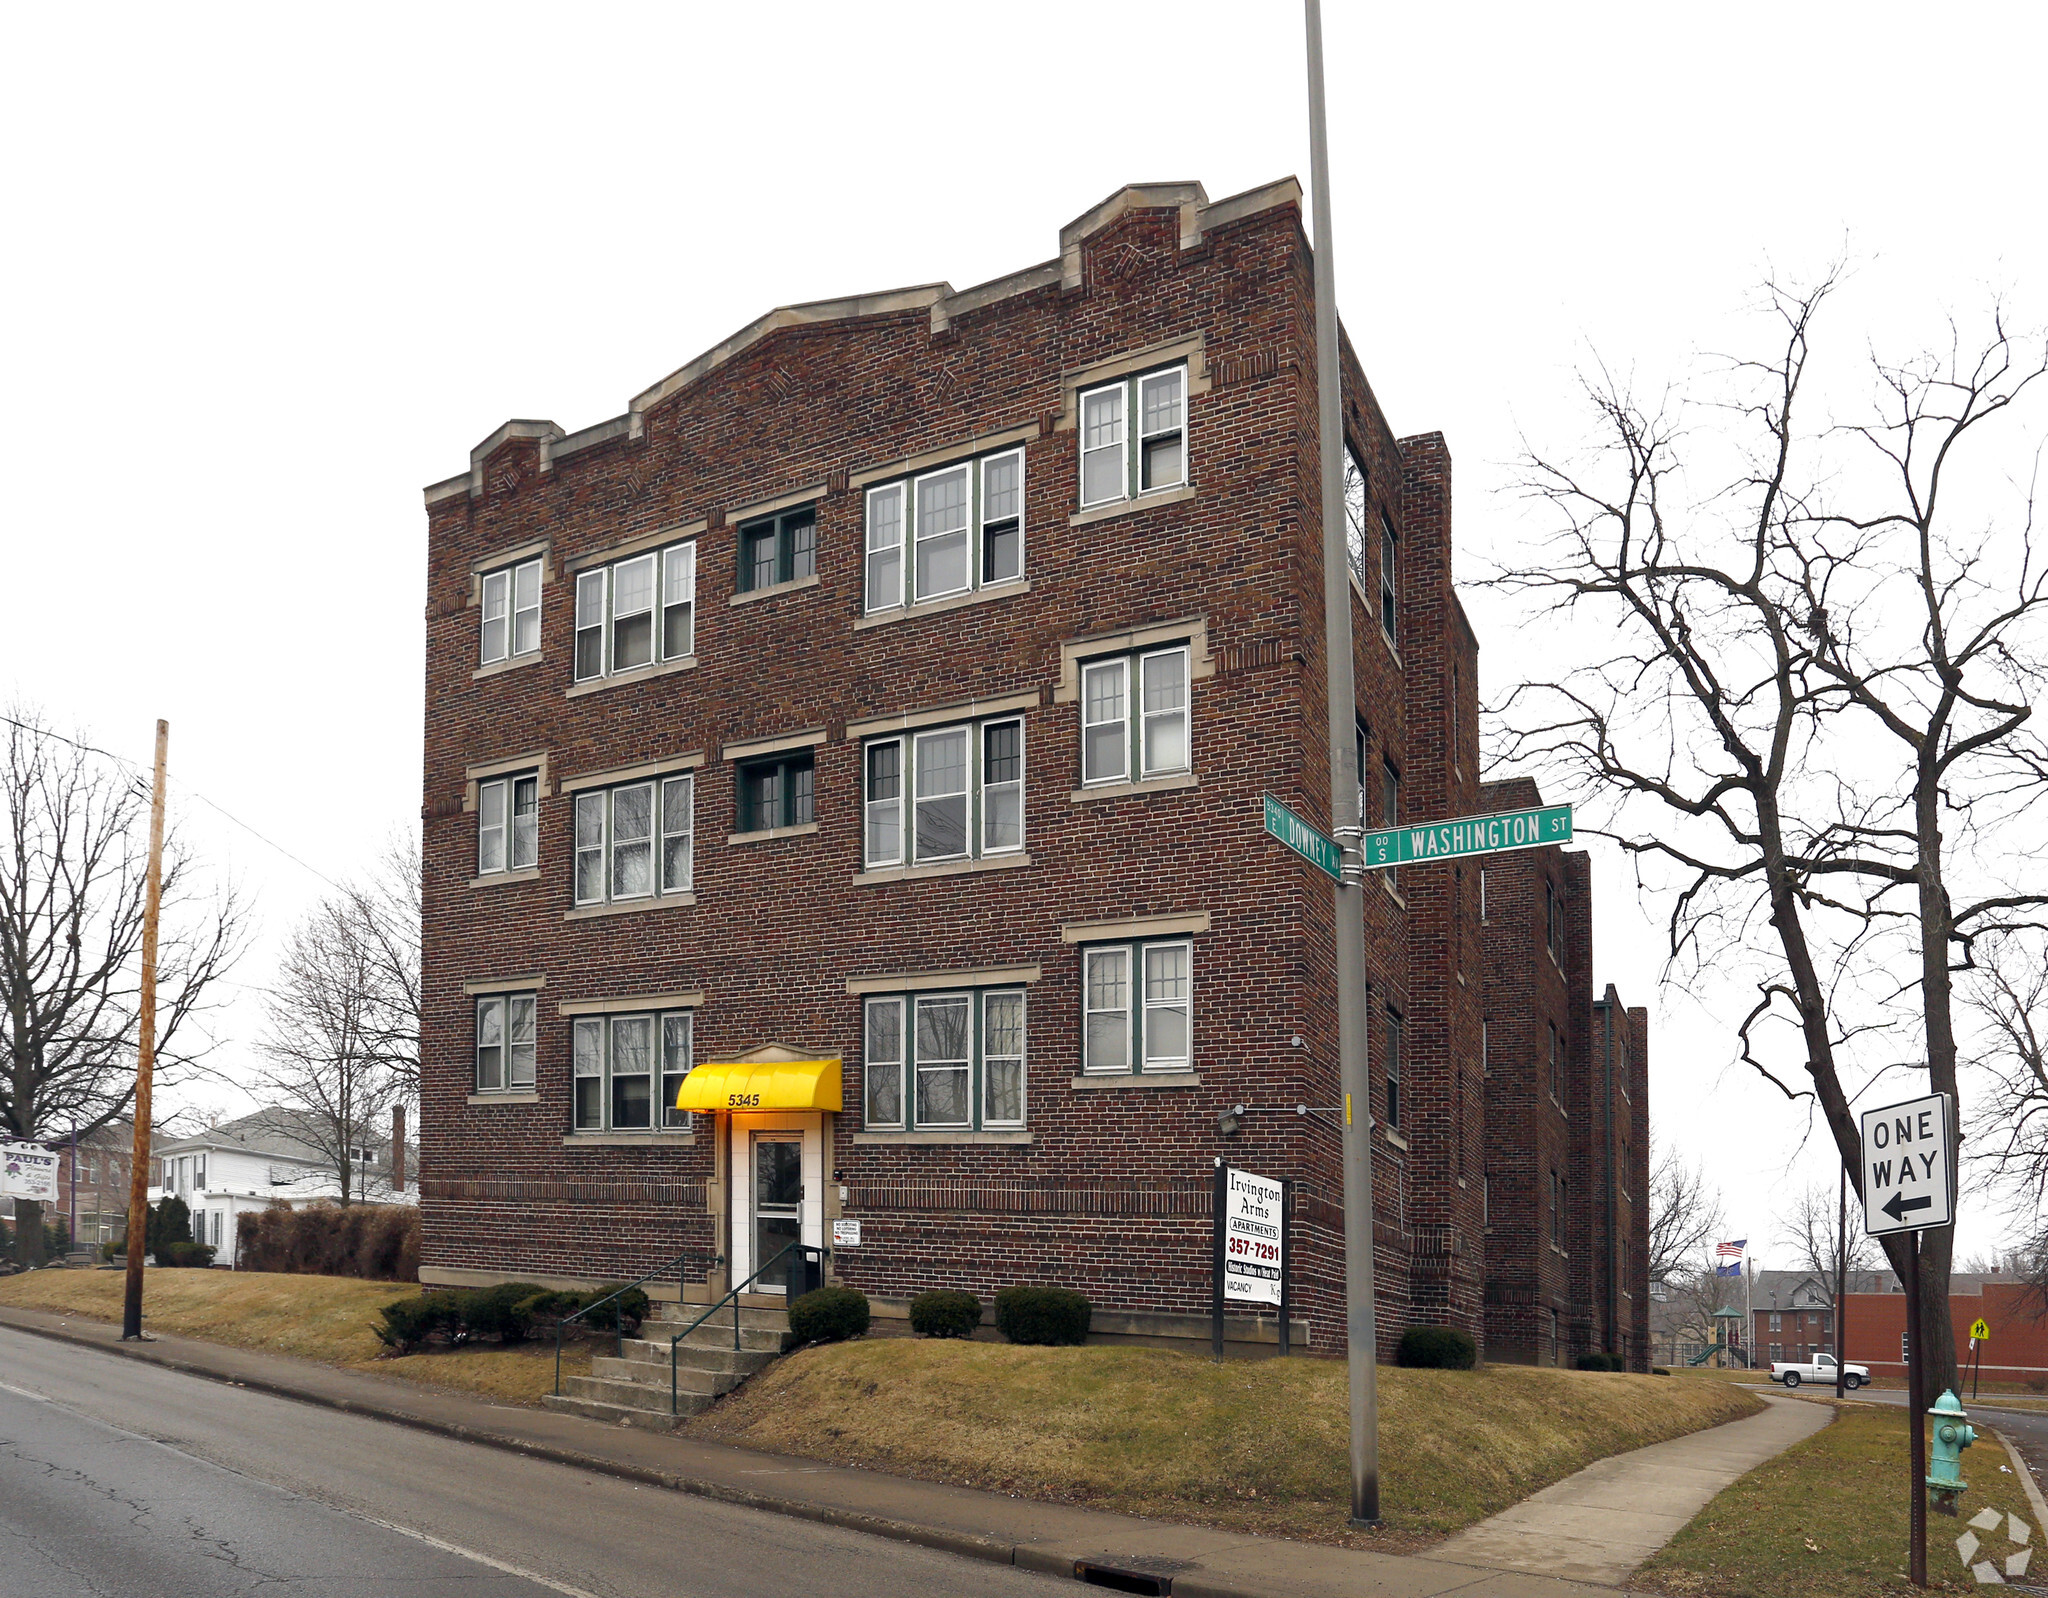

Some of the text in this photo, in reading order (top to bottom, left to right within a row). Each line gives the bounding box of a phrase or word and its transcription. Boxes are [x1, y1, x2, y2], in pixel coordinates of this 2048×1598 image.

[1272, 817, 1277, 832] E
[1411, 814, 1567, 857] WASHINGTON ST
[1289, 817, 1339, 870] DOWNEY AV
[1379, 848, 1387, 862] S
[728, 1094, 760, 1107] 5345
[1873, 1110, 1934, 1149] ONE
[6, 1153, 51, 1165] PAUL'S
[1872, 1150, 1938, 1189] WAY
[1230, 1172, 1281, 1205] Irvington
[1241, 1196, 1269, 1219] Arms
[1232, 1220, 1277, 1238] APARTMENTS
[1229, 1237, 1279, 1261] 357-7291
[1226, 1280, 1253, 1294] VACANCY
